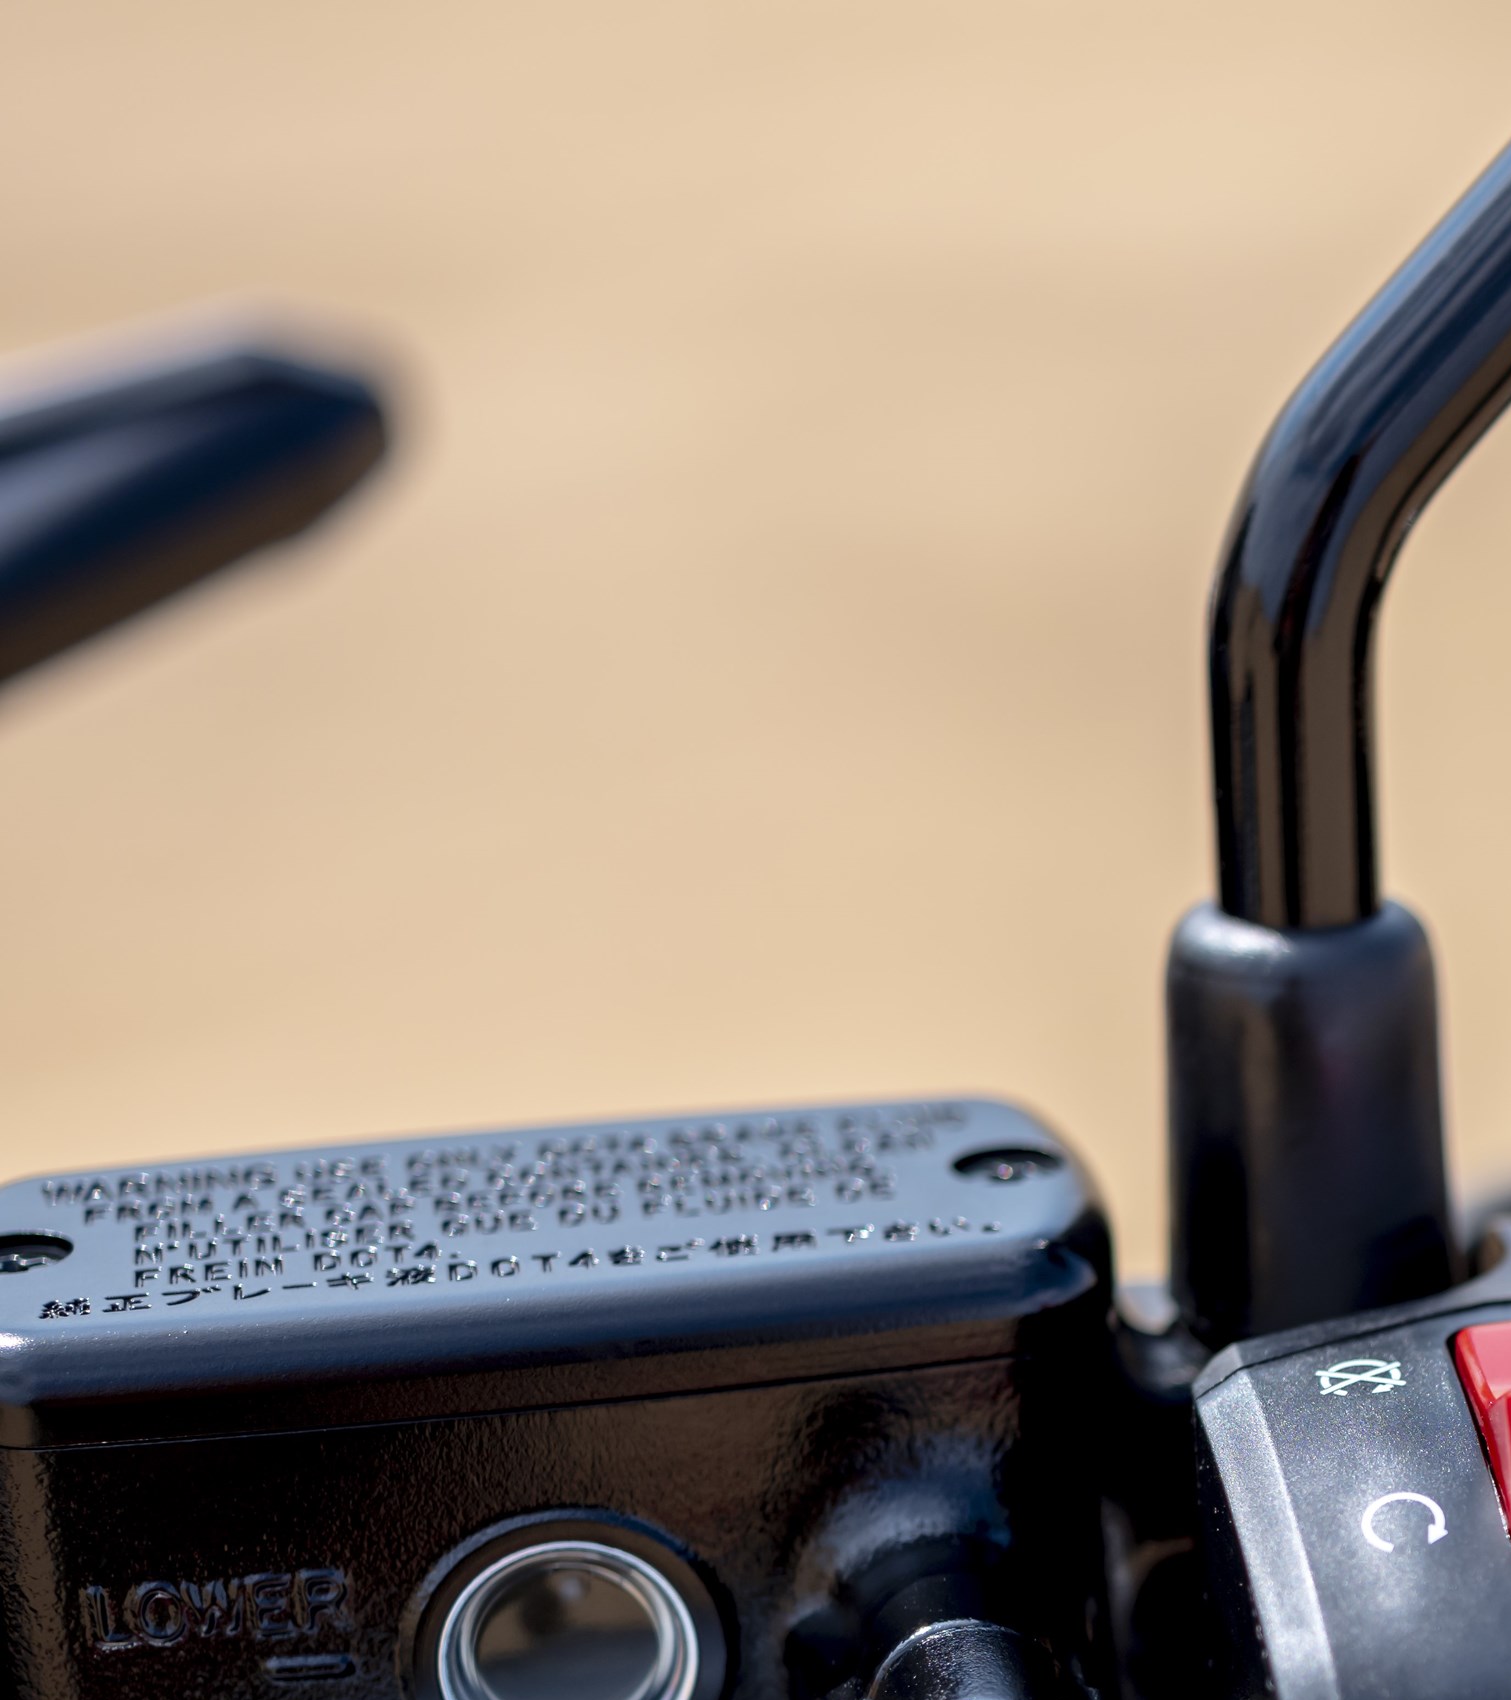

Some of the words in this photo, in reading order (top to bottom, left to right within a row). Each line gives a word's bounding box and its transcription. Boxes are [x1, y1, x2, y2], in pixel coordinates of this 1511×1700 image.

[41, 1165, 275, 1206] WARNING
[293, 1155, 388, 1184] USE
[84, 1195, 213, 1227] FROM
[232, 1192, 260, 1214] A
[134, 1207, 305, 1244] FILLER
[324, 1196, 416, 1227] CAP
[440, 1207, 538, 1239] QUE
[557, 1199, 620, 1229] DU
[134, 1255, 284, 1289] FREIN
[84, 1568, 354, 1650] LOWER
